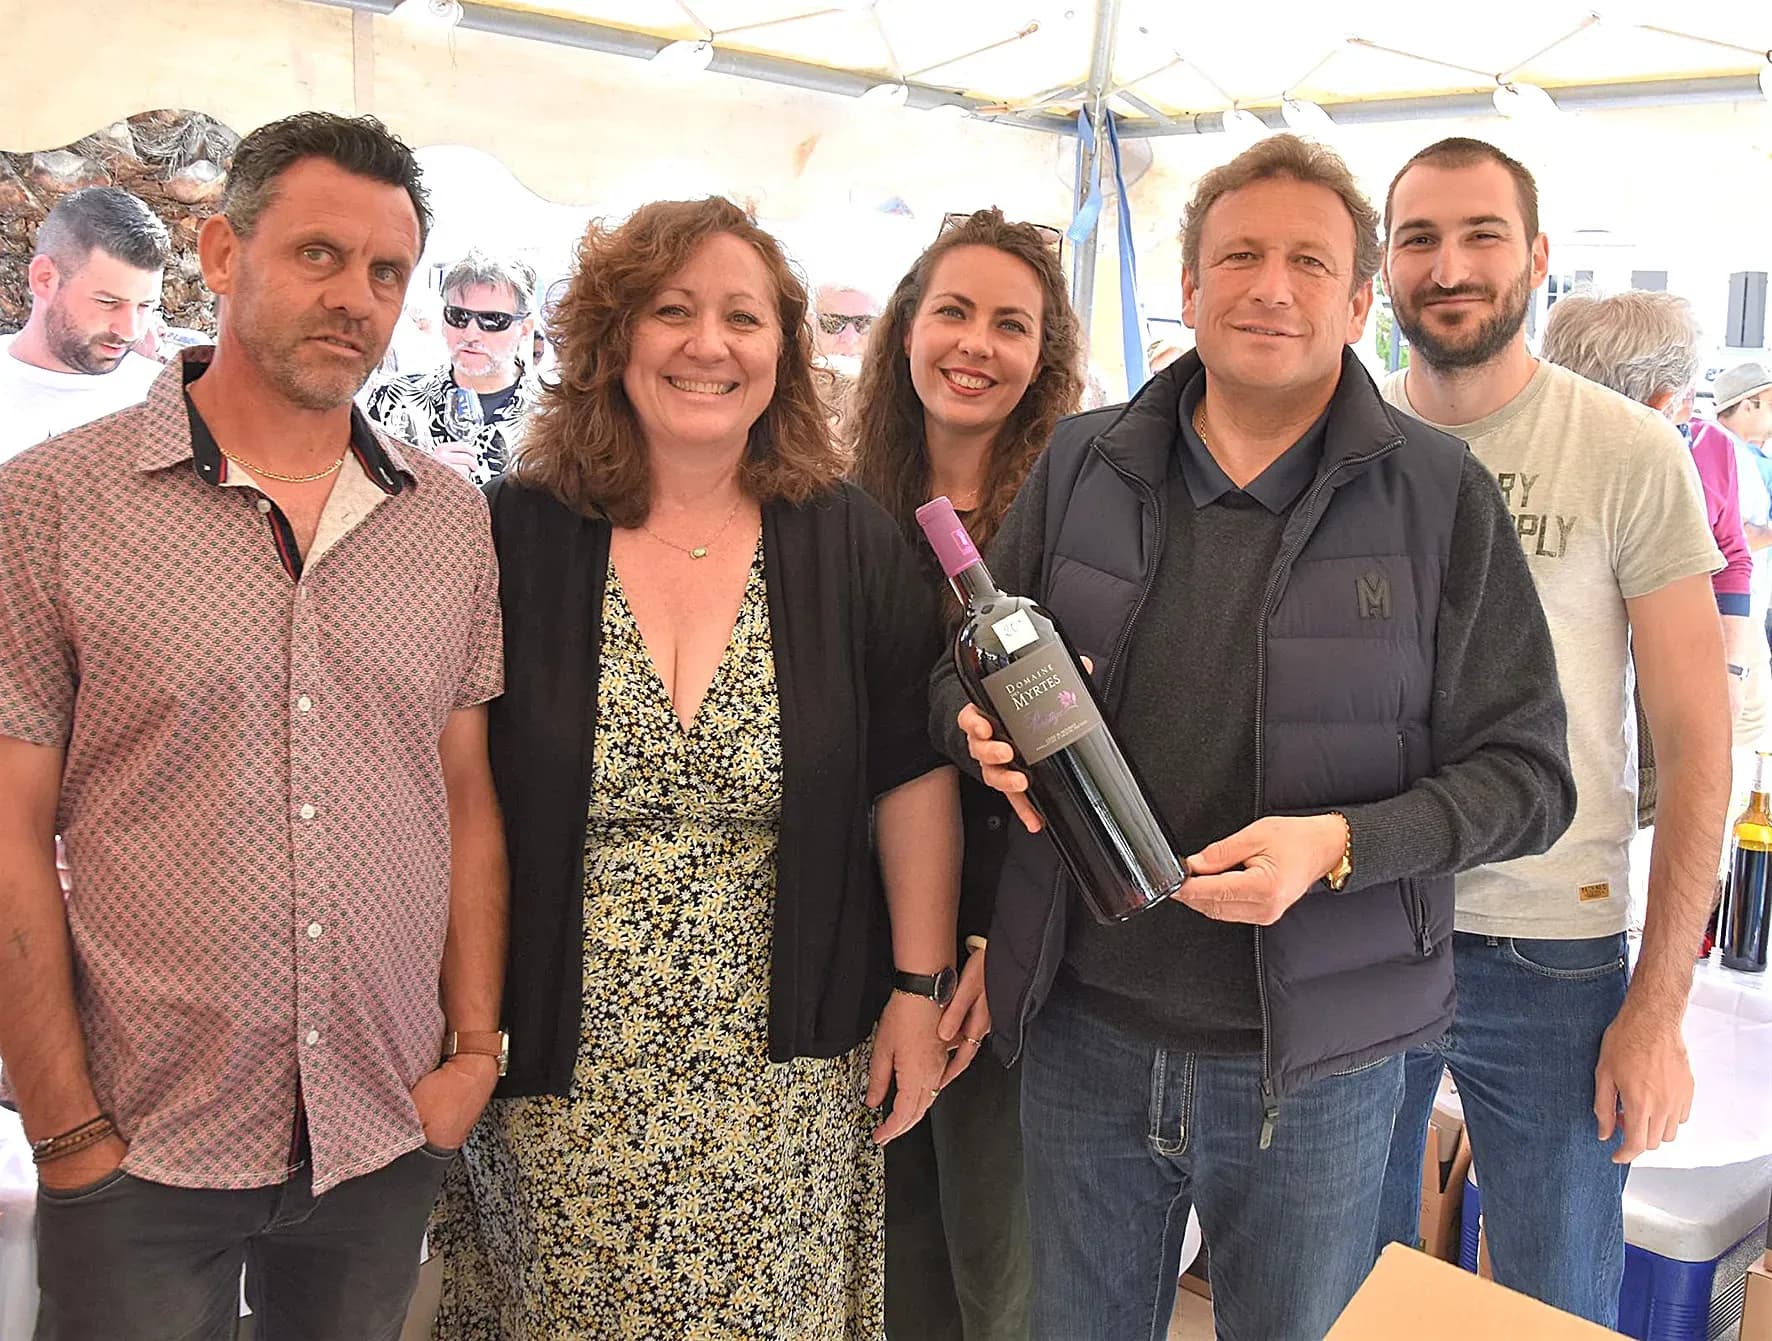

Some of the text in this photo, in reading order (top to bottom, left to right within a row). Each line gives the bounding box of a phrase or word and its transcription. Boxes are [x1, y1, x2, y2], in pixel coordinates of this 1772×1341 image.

[1498, 472, 1540, 508] RY
[1511, 513, 1577, 558] PLY
[1005, 664, 1055, 694] DOMAINE
[1012, 674, 1061, 710] MYRTES
